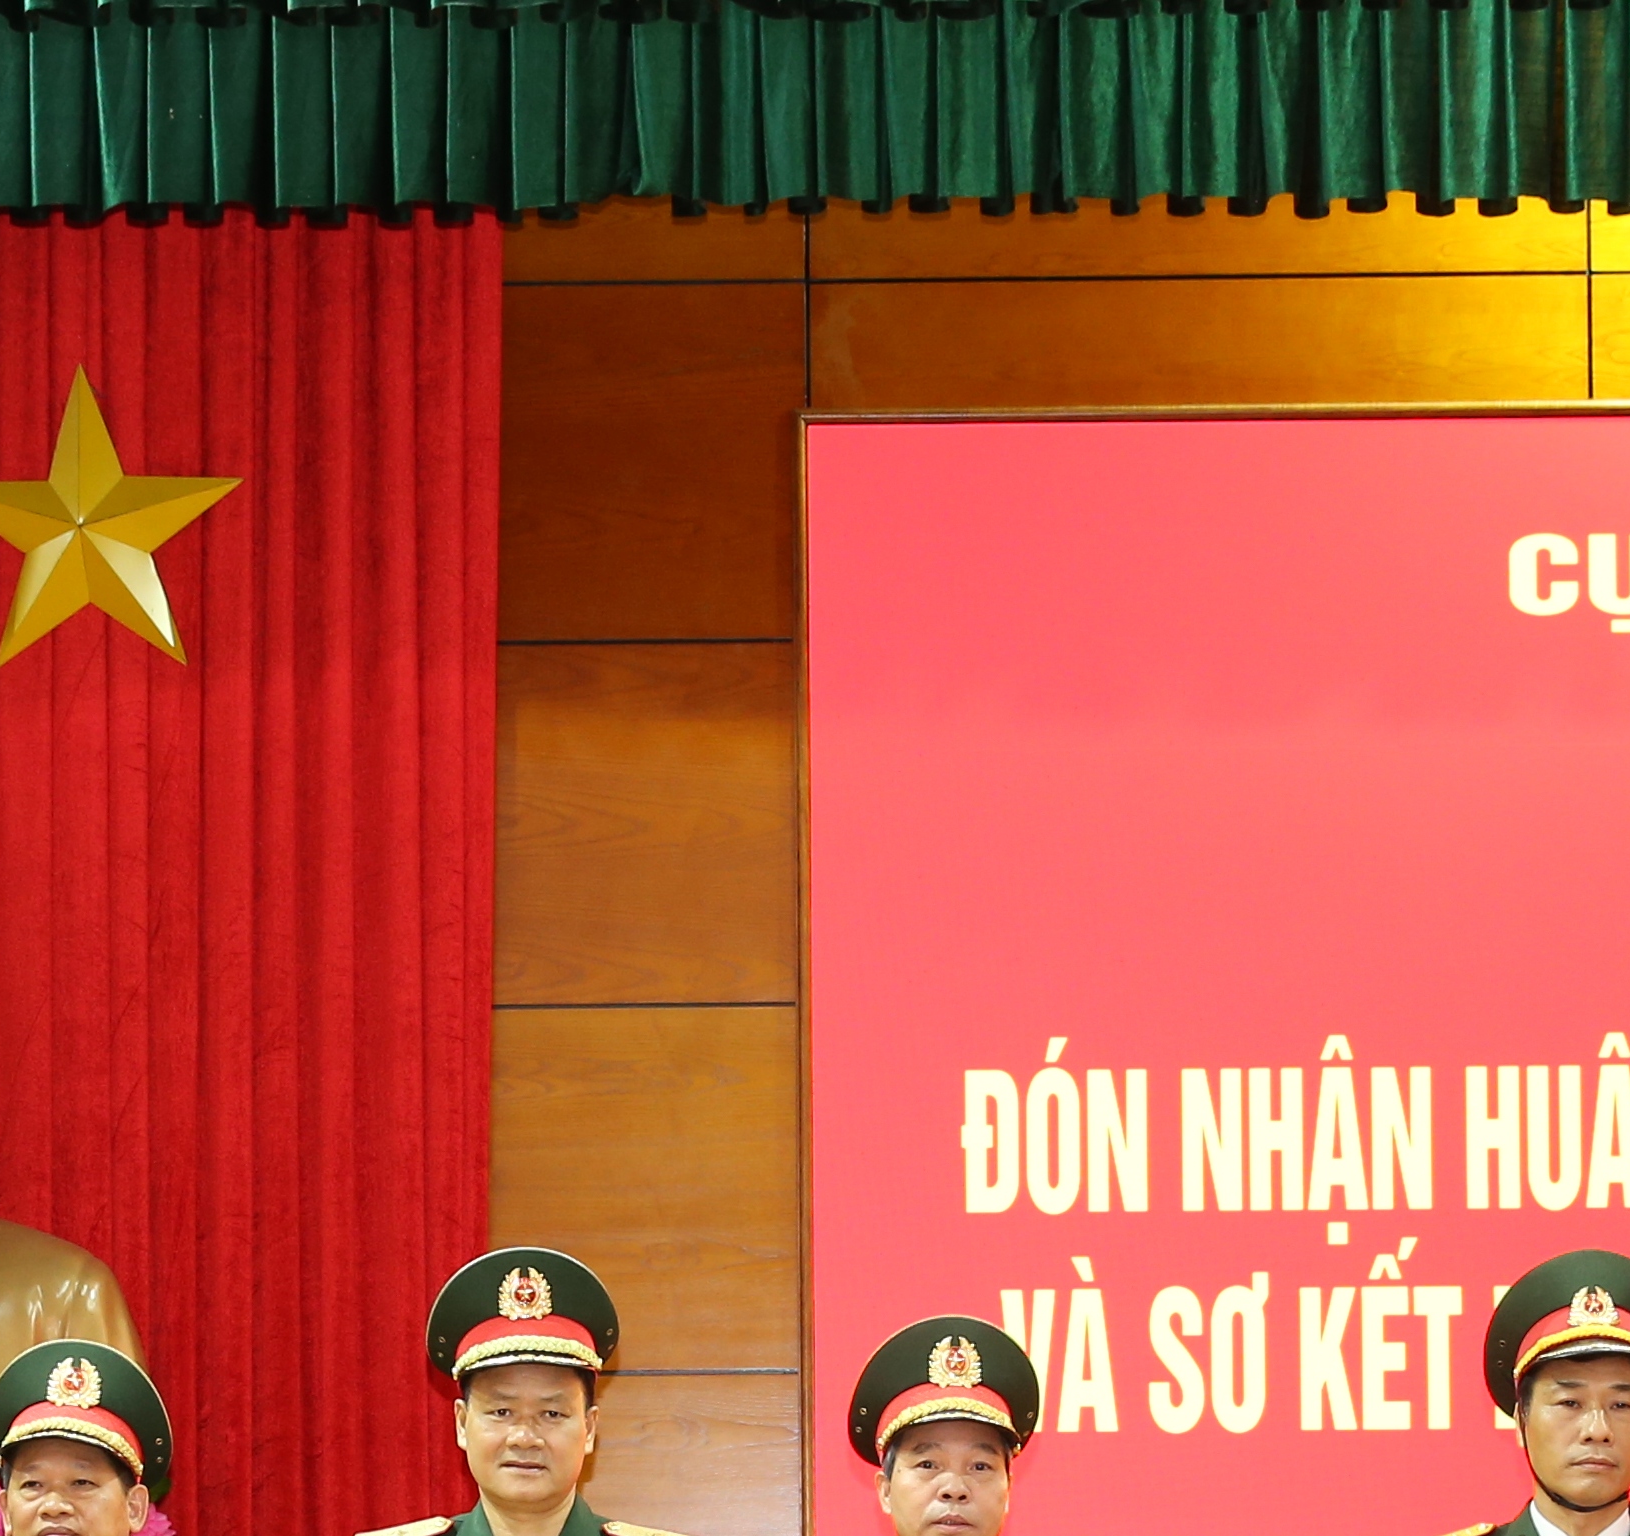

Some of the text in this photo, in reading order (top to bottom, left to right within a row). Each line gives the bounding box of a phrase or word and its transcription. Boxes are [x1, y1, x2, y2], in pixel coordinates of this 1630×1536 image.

[960, 1036, 1149, 1216] ĐÓN
[1180, 1034, 1433, 1246] NHẬN
[1000, 1255, 1119, 1433] VÀ
[1148, 1271, 1270, 1435] SƠ
[1298, 1236, 1463, 1431] KẾT
